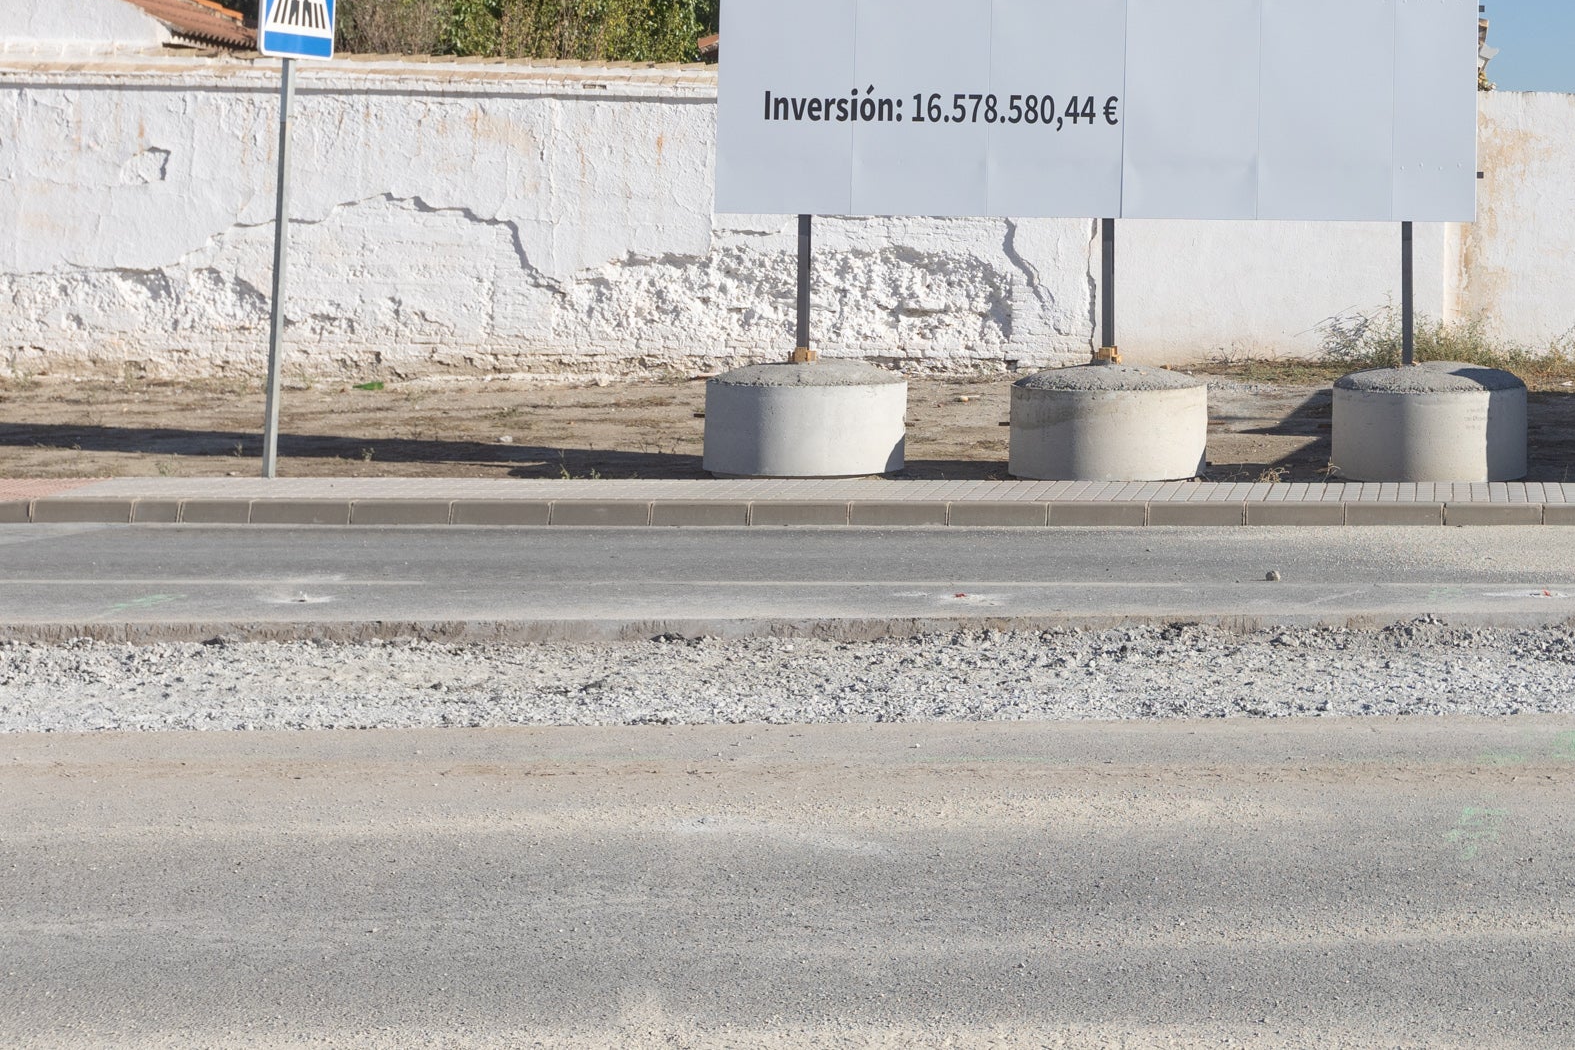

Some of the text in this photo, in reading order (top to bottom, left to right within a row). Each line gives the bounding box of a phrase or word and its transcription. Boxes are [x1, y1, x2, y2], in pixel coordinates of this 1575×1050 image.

[764, 84, 1119, 132] Inversión: 16.578.580,44 €
